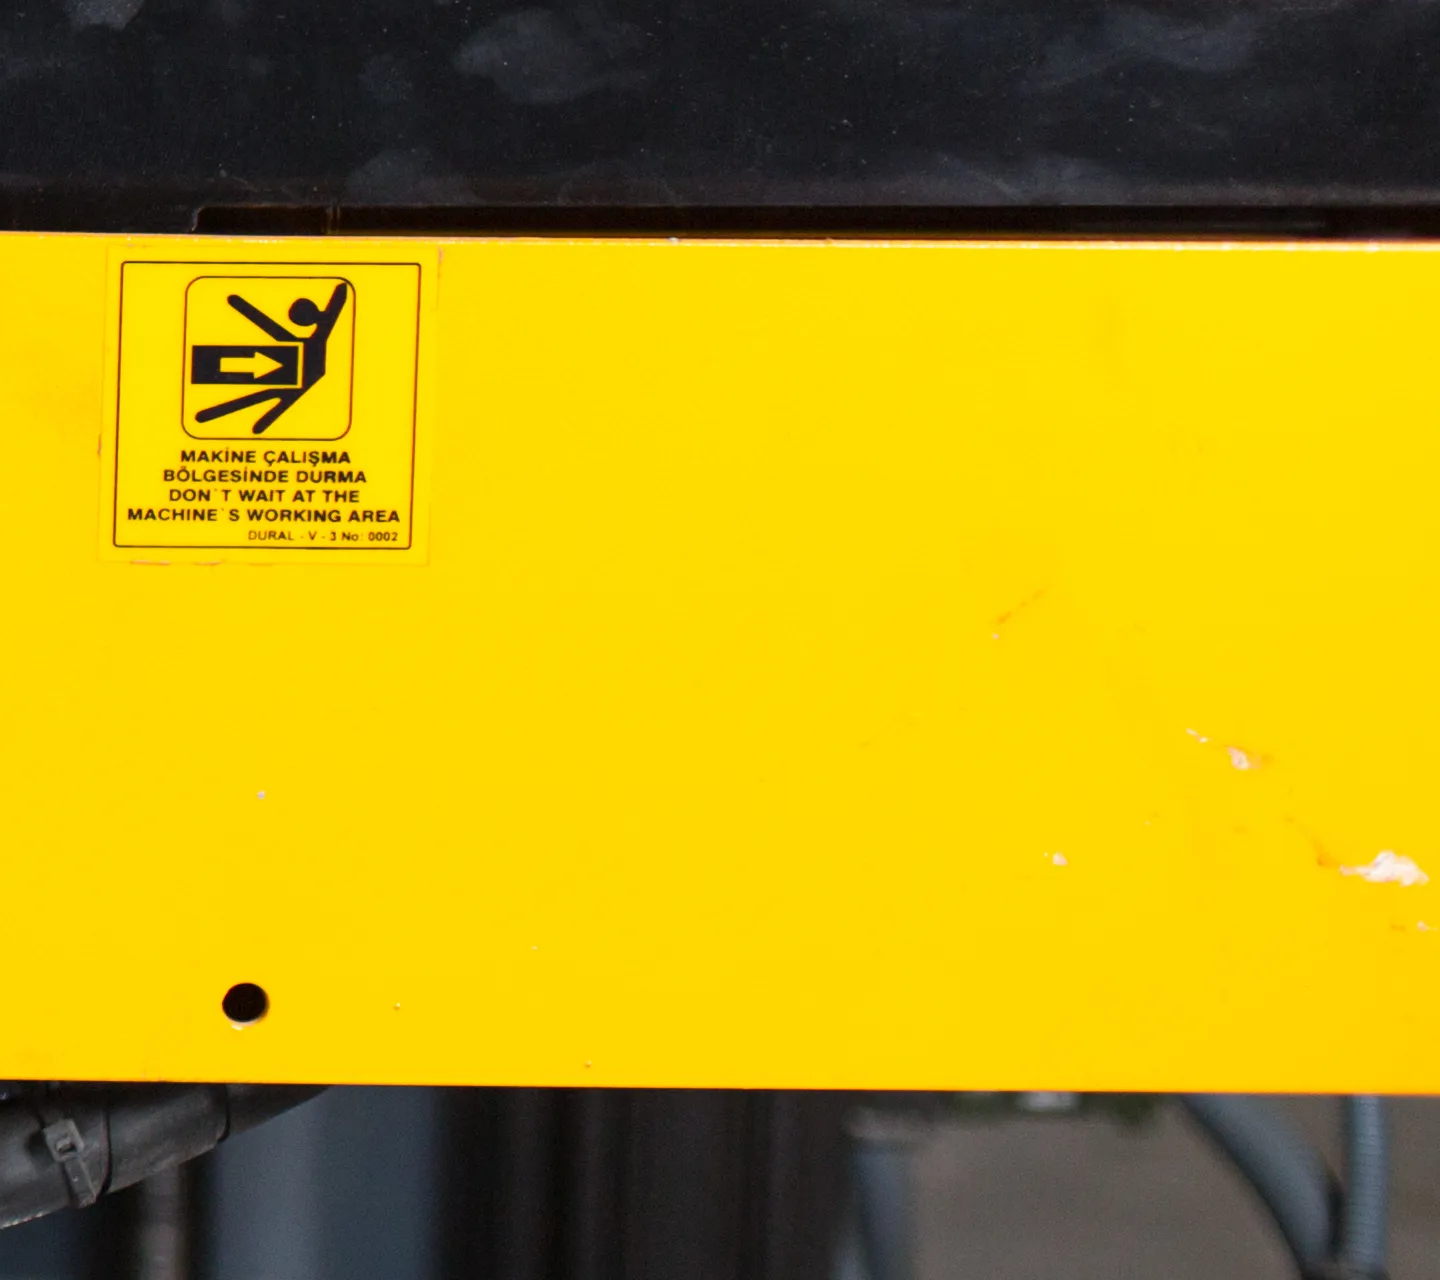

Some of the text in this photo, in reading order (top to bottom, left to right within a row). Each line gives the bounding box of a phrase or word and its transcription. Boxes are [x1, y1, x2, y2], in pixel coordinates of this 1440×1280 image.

[180, 447, 352, 467] MAKİNE ÇALIŞMA
[163, 466, 367, 483] BÖLGESİNDE DURMA
[238, 489, 286, 502] WAIT
[292, 489, 316, 502] AT
[323, 489, 360, 503] THE
[247, 508, 342, 523] WORKING
[348, 509, 401, 523] AREA
[248, 530, 294, 541] DURAL
[308, 531, 317, 542] V
[330, 532, 337, 542] 3
[368, 532, 398, 543] 0002
